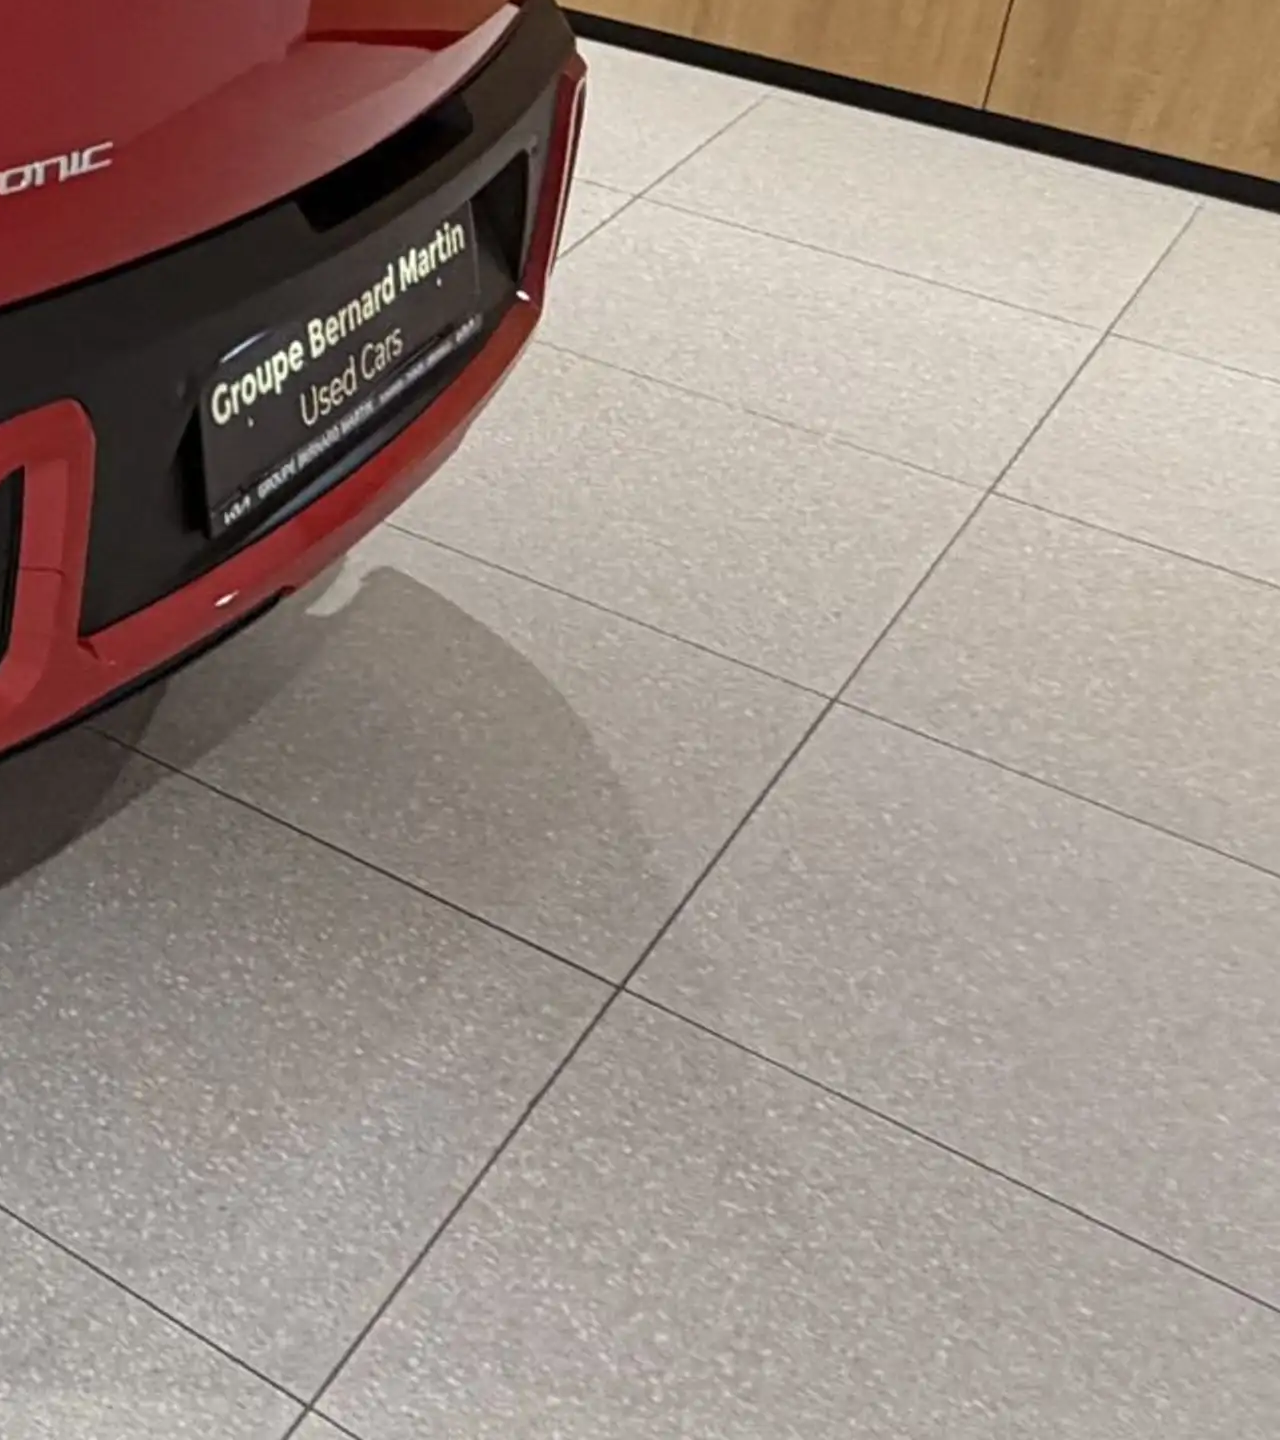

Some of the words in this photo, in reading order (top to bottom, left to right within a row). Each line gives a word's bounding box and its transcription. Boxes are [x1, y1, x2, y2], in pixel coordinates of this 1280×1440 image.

[210, 339, 305, 426] Groupe
[307, 261, 396, 360] Bernard
[397, 220, 466, 293] Martin
[299, 354, 358, 429] Used
[360, 327, 405, 381] Cars
